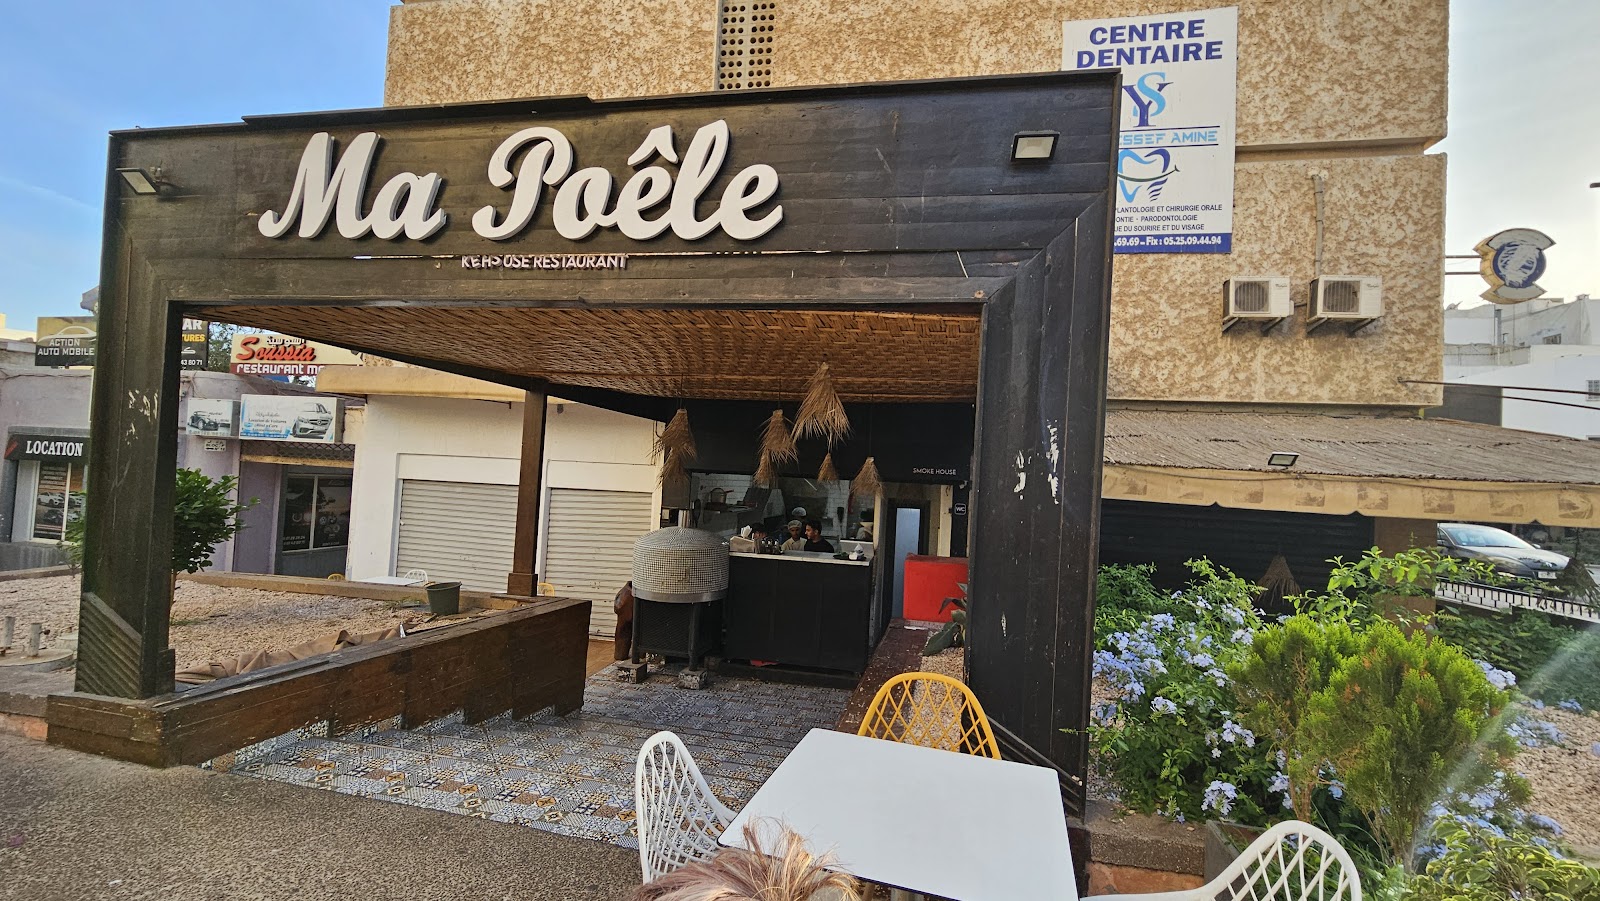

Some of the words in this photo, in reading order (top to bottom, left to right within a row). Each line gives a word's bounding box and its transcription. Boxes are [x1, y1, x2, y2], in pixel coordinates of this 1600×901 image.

[1089, 19, 1206, 46] CENTRE
[1076, 40, 1223, 68] DENTAIRE
[1119, 133, 1166, 146] SSEF
[1170, 130, 1218, 143] AMINE
[257, 131, 447, 241] Ma
[471, 119, 784, 242] Poêle
[1115, 206, 1156, 214] LANTOLOGIE
[1165, 204, 1200, 212] CHIRURGIE
[1140, 214, 1198, 222] PARODONTOLOGIE
[1133, 224, 1161, 232] SOURIRE
[1163, 236, 1222, 246] 05.25.09.44.94
[533, 254, 629, 269] RESTAURANT
[182, 318, 203, 330] AR
[49, 338, 80, 347] ACTION
[37, 347, 60, 356] AUTO
[61, 347, 95, 356] MOBILE
[236, 336, 317, 362] Soussia
[236, 362, 304, 375] restaurant
[25, 440, 84, 457] LOCATION
[912, 467, 935, 475] SMOKE
[935, 468, 957, 476] HOUSE
